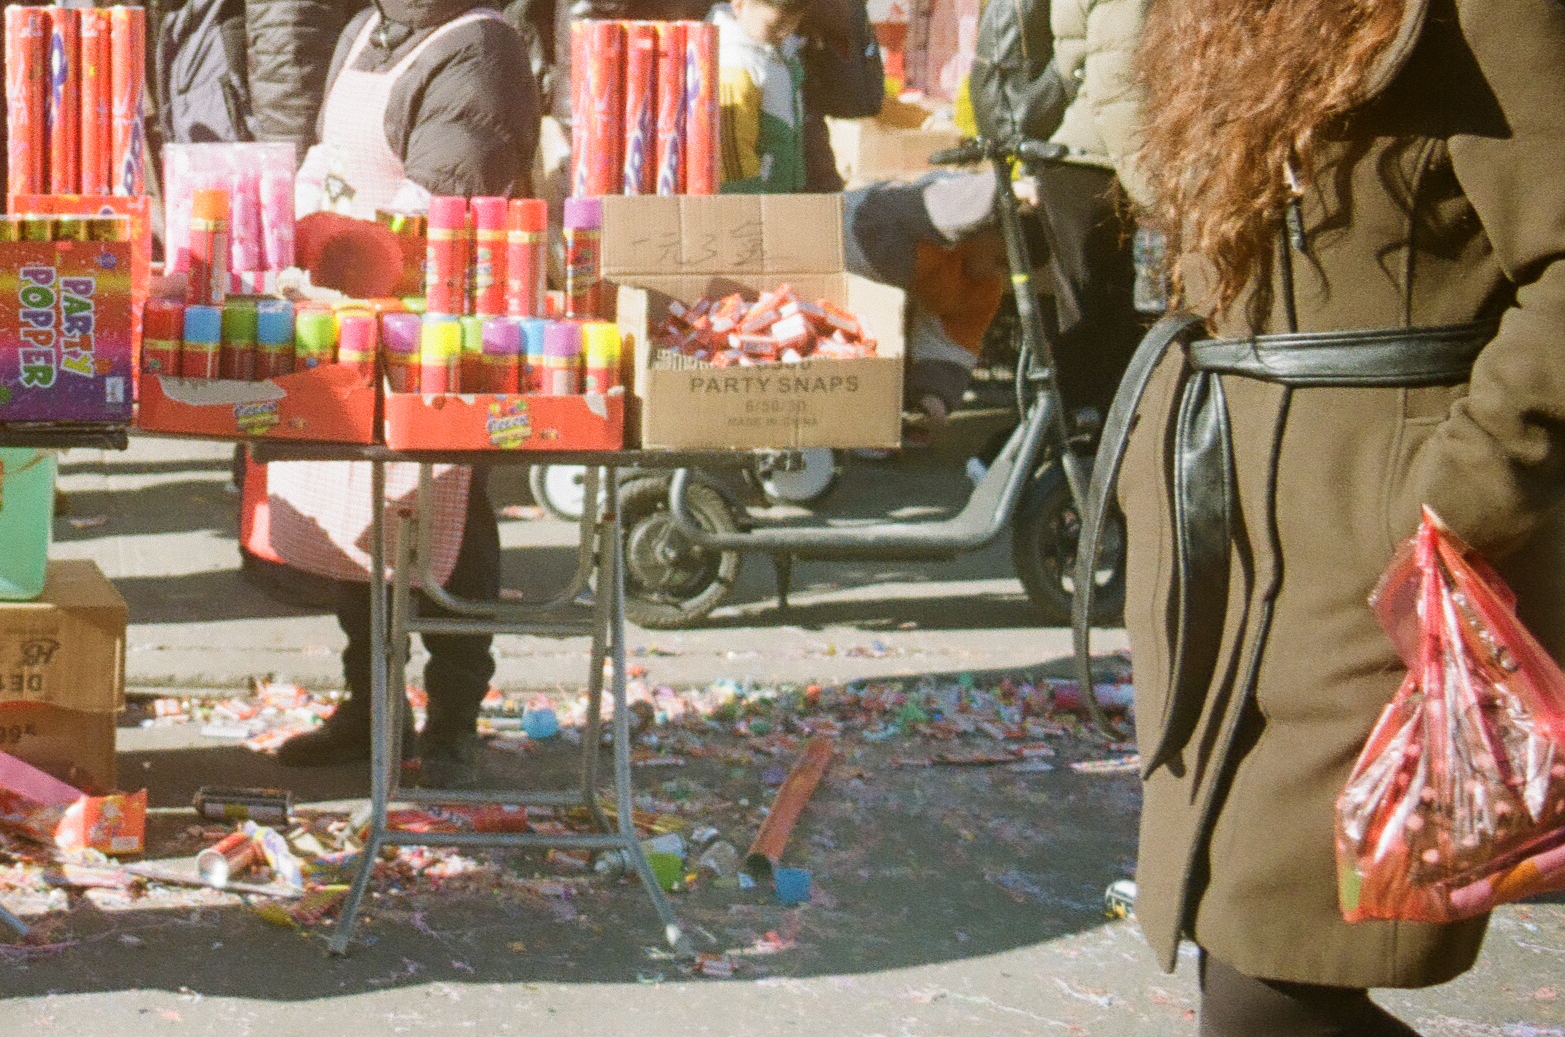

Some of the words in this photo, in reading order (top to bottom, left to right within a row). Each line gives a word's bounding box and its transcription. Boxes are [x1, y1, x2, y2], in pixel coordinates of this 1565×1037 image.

[18, 266, 56, 388] POPPER
[58, 276, 96, 379] PARTY
[689, 375, 772, 394] PARTY
[777, 374, 859, 393] SNAPS
